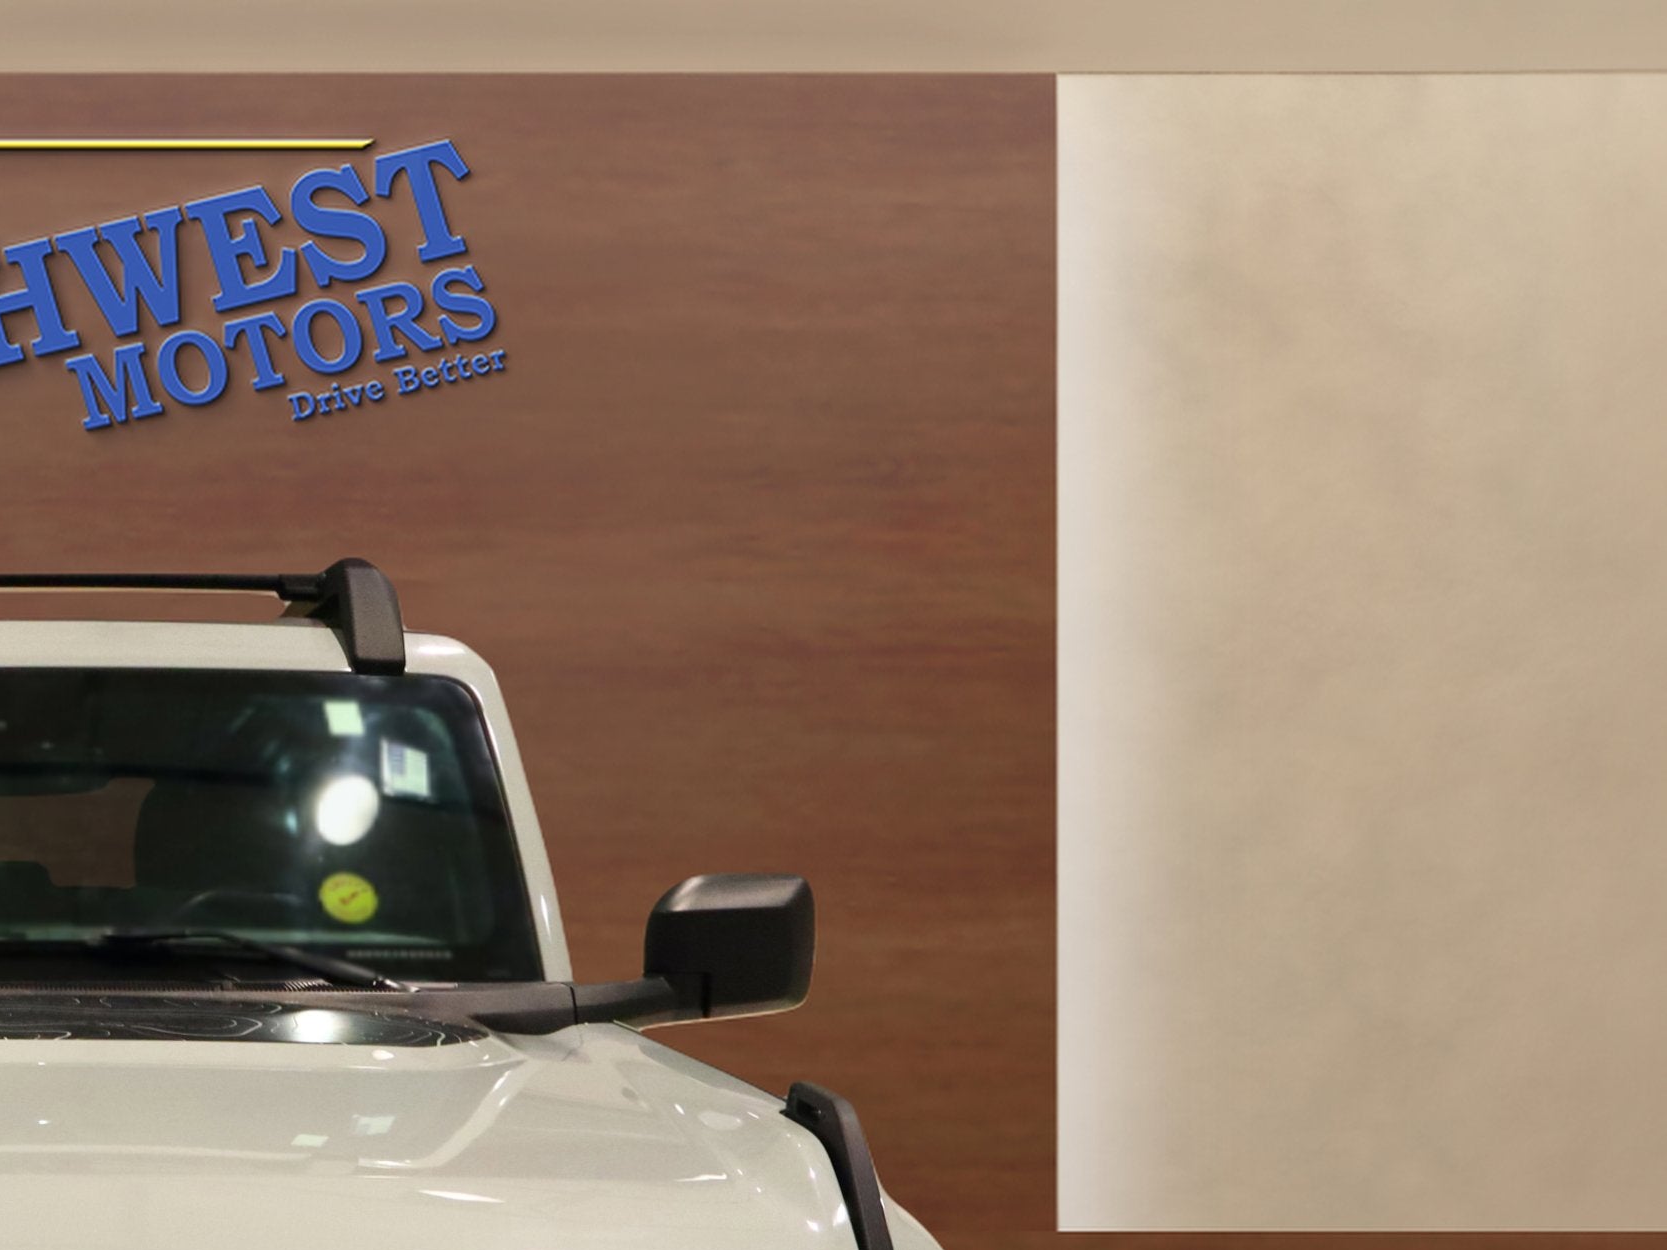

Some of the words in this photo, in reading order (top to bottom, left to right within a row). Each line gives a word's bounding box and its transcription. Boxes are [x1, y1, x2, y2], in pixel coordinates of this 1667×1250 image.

[65, 265, 498, 431] MOTORS
[287, 383, 385, 421] Drive
[393, 349, 506, 395] Better
